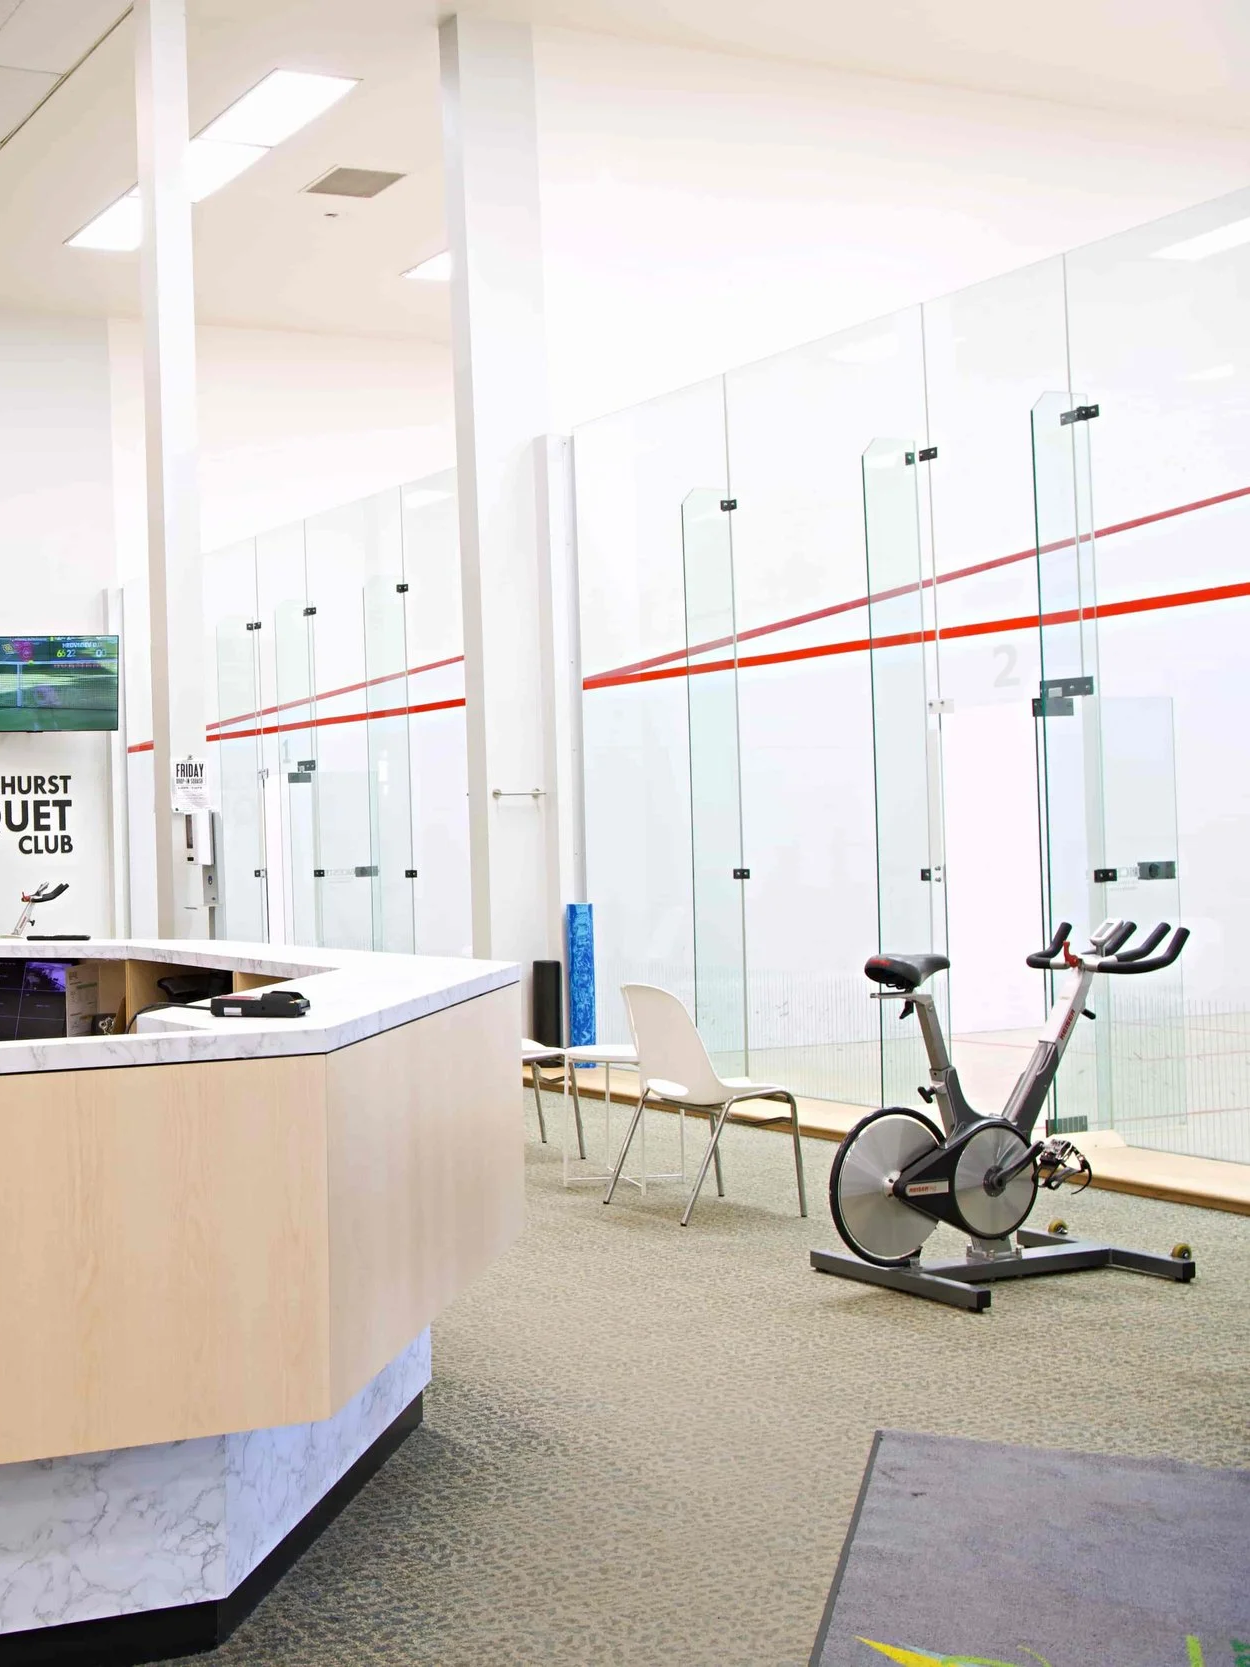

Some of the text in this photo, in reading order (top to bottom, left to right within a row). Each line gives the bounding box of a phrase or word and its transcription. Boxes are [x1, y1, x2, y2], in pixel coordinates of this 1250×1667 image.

[993, 644, 1021, 688] 2
[283, 739, 291, 764] 1
[176, 763, 204, 778] FRIDAY
[18, 835, 73, 854] CLUB
